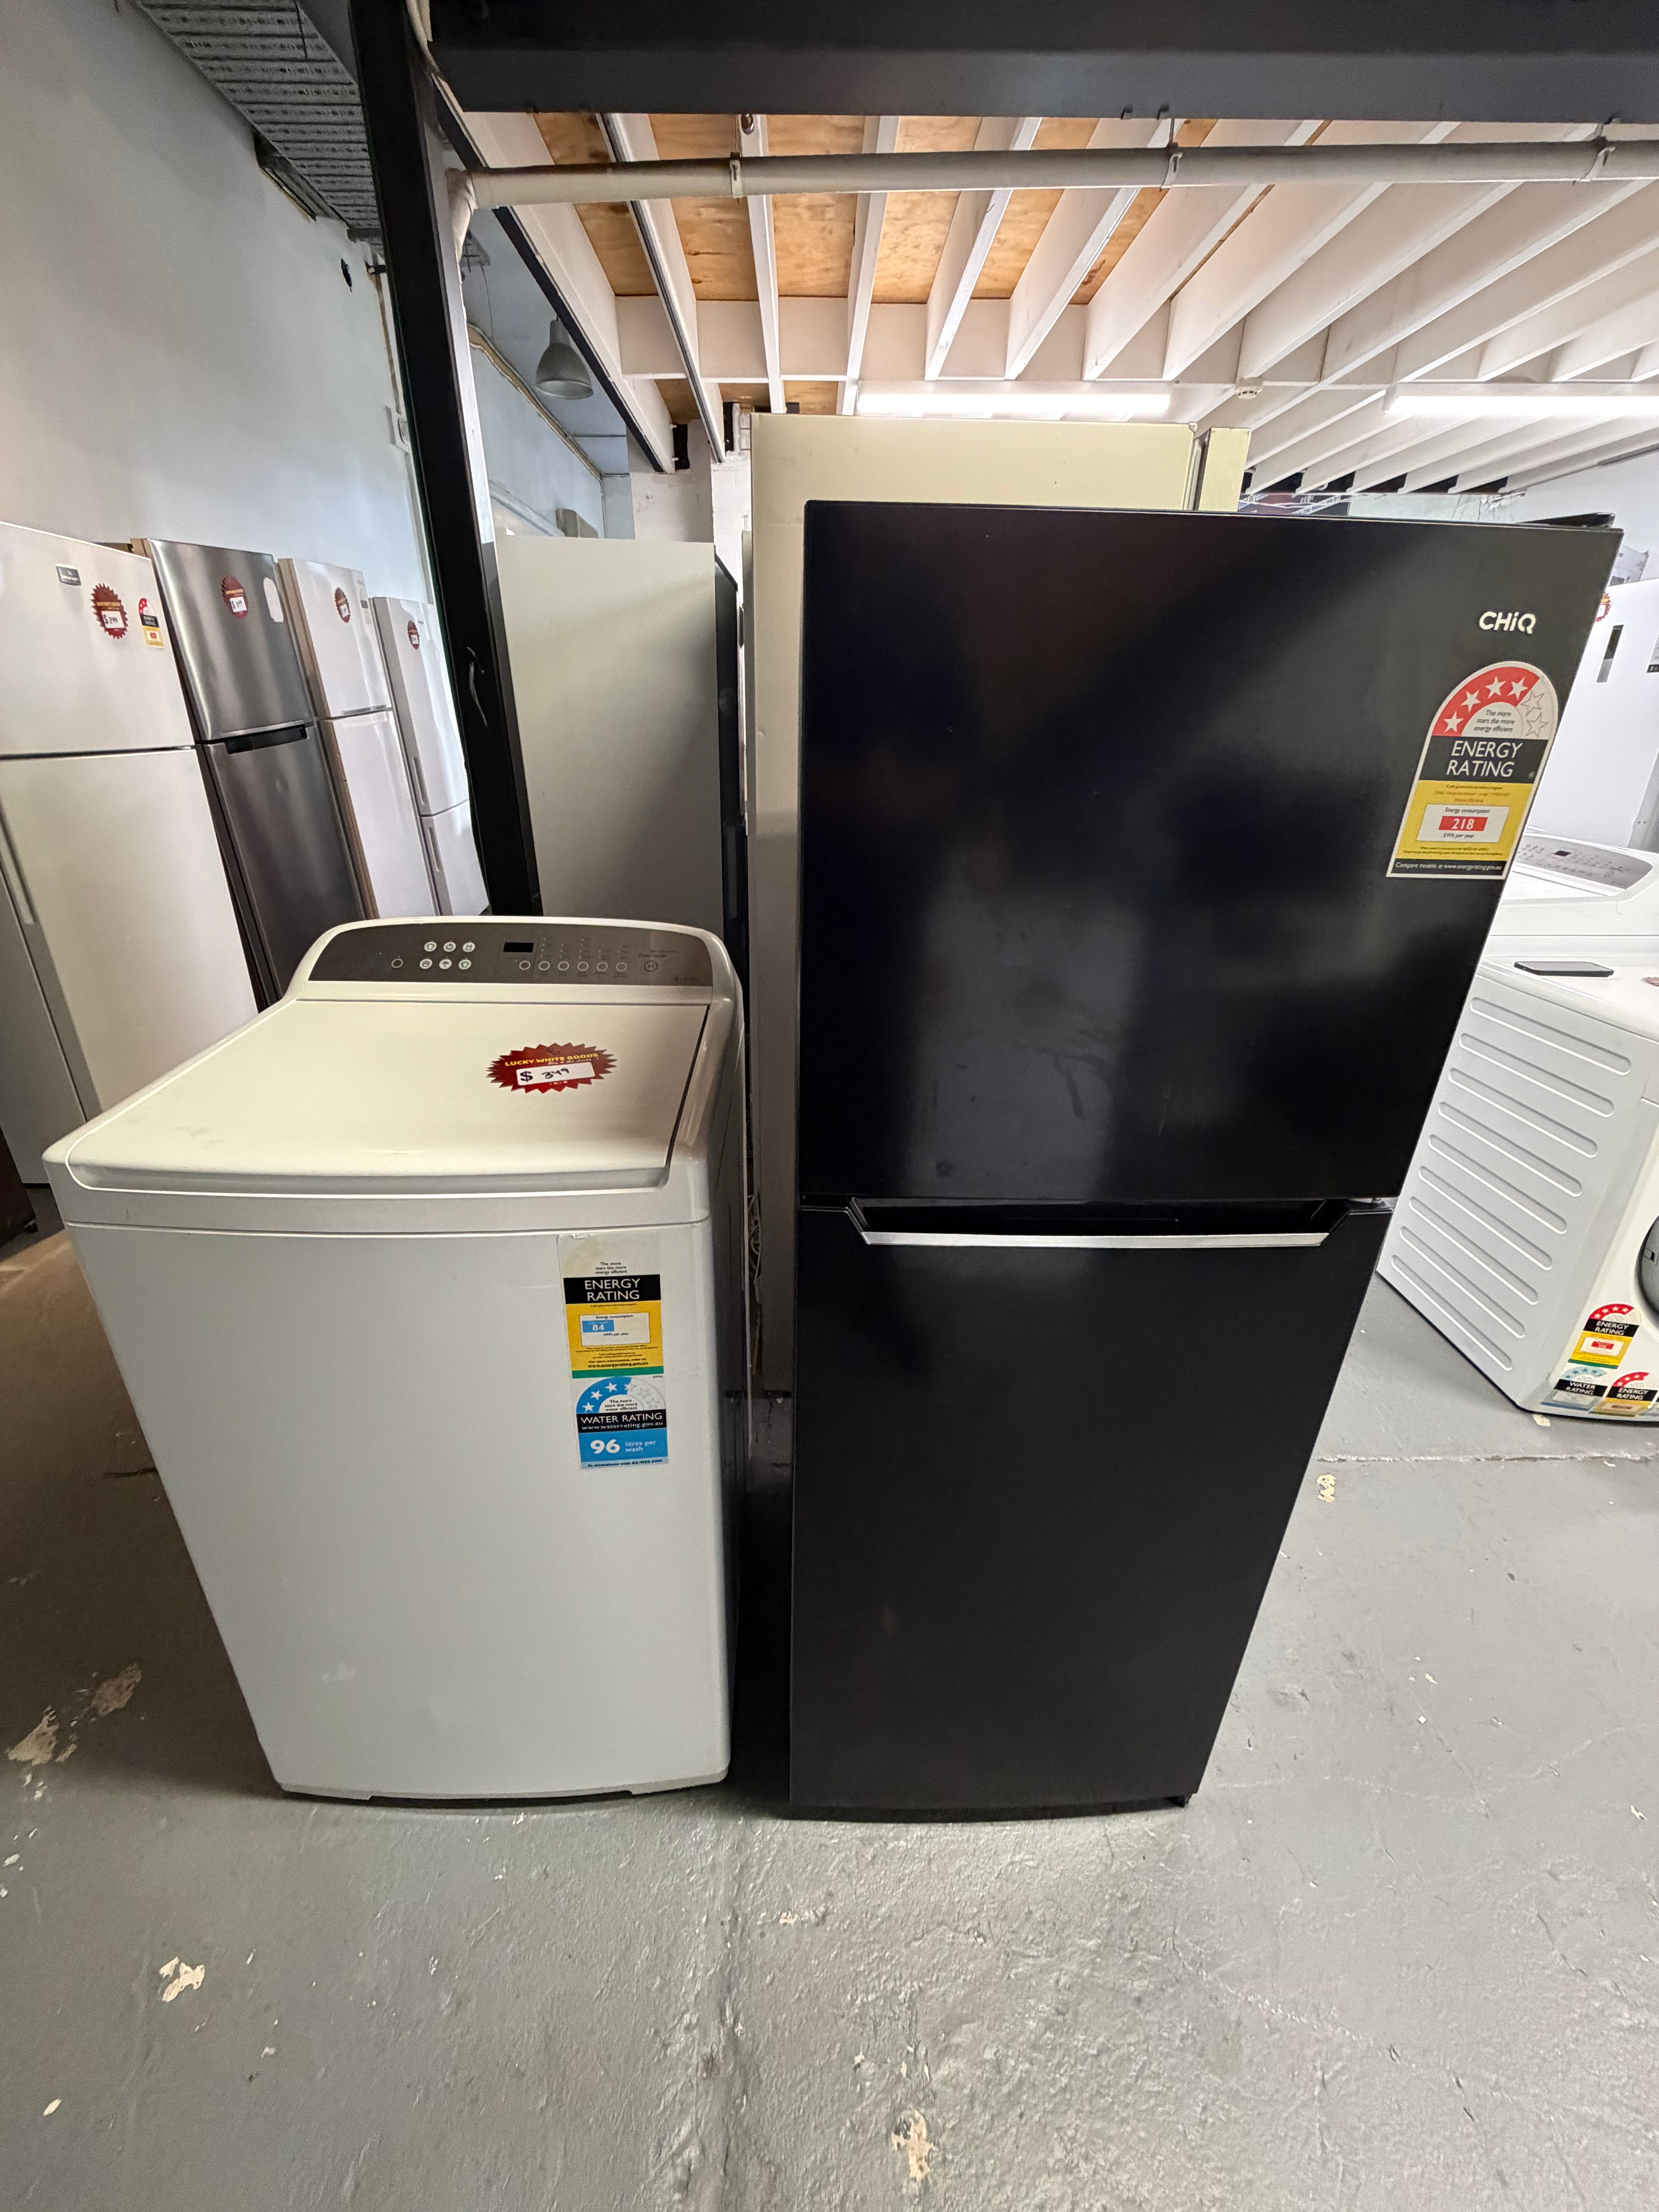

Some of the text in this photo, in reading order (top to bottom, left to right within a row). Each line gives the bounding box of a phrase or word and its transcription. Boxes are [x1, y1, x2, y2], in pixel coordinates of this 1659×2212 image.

[1479, 611, 1536, 634] CHiQ
[1451, 740, 1523, 758] ENERGY
[1446, 759, 1515, 777] RATING
[1451, 818, 1475, 830] 218
[520, 1068, 570, 1082] $ 349
[584, 1278, 641, 1290] ENERGY
[587, 1290, 640, 1302] RATING
[1594, 1327, 1625, 1336] RATING
[1596, 1321, 1629, 1330] ENERGY
[1565, 1386, 1594, 1395] RATING
[1570, 1381, 1595, 1390] WATER
[580, 1413, 663, 1424] WATER RATING
[581, 1421, 663, 1430] www.waterrating.gov.au
[590, 1439, 620, 1454] 96
